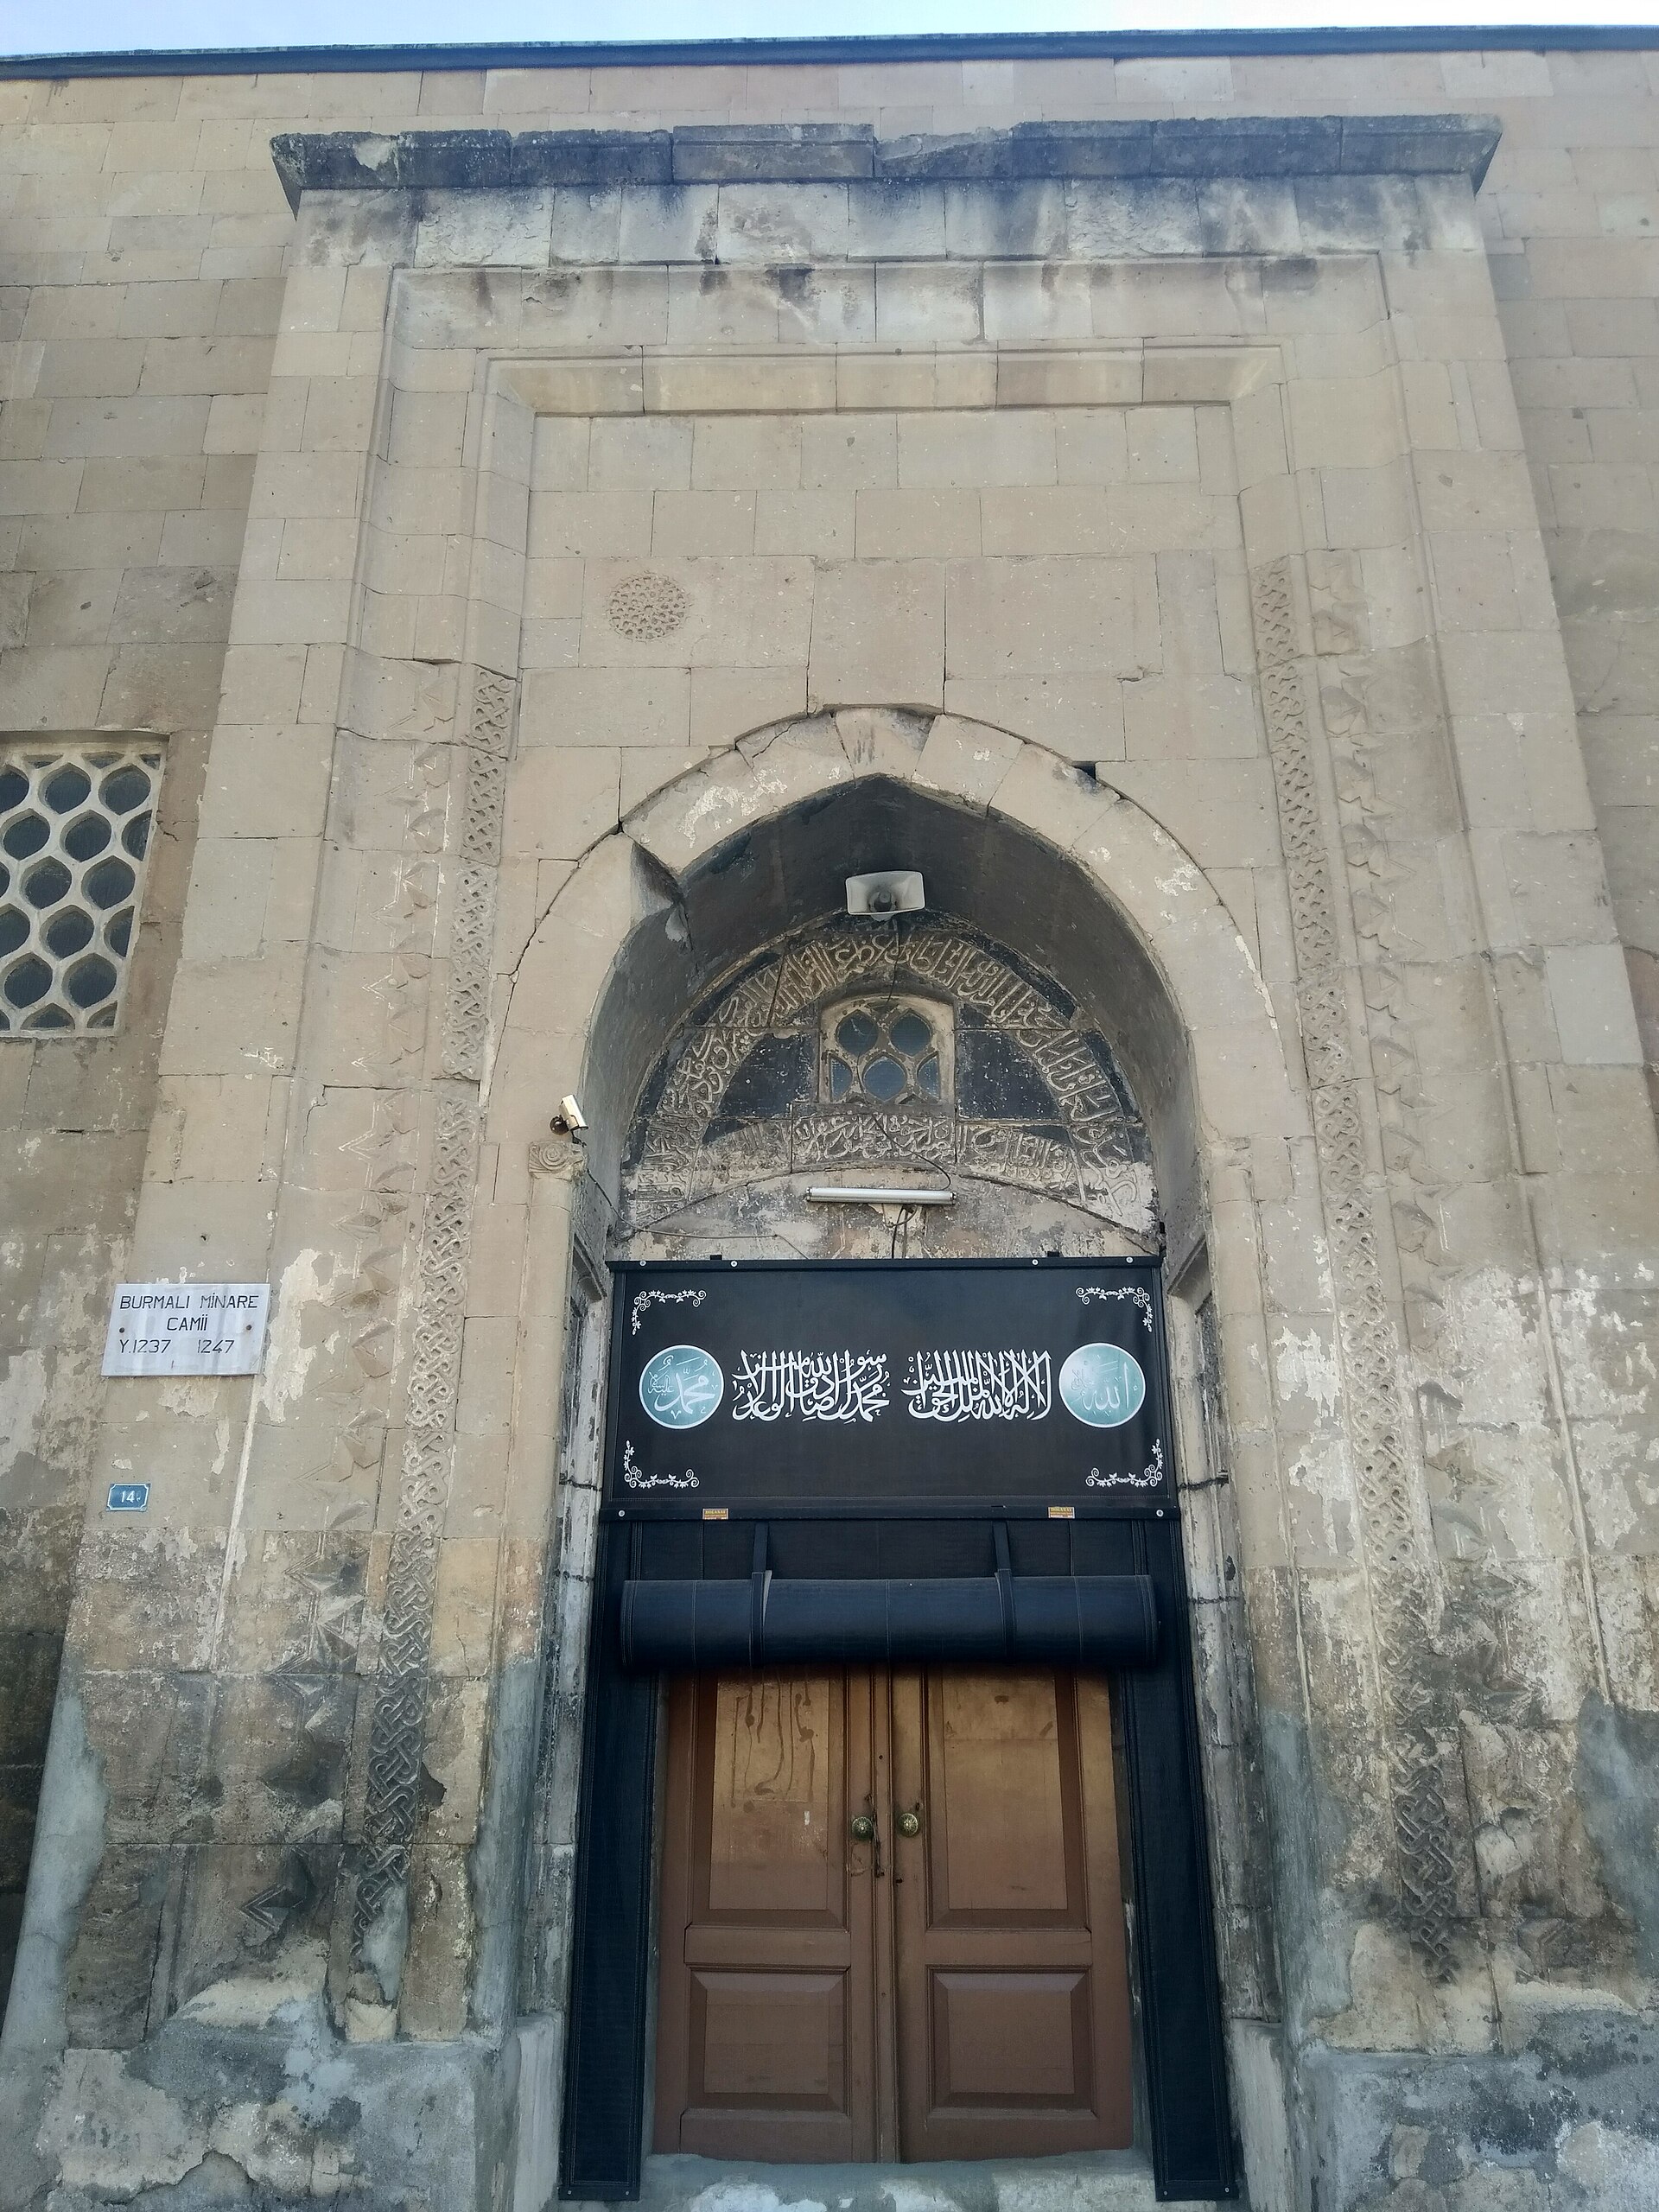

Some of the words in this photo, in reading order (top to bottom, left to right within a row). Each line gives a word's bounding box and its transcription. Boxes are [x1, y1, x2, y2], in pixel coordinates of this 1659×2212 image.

[119, 1295, 191, 1310] BURMALI
[200, 1292, 259, 1309] MİNARE
[166, 1313, 208, 1332] CAMİİ
[197, 1339, 236, 1354] 1247
